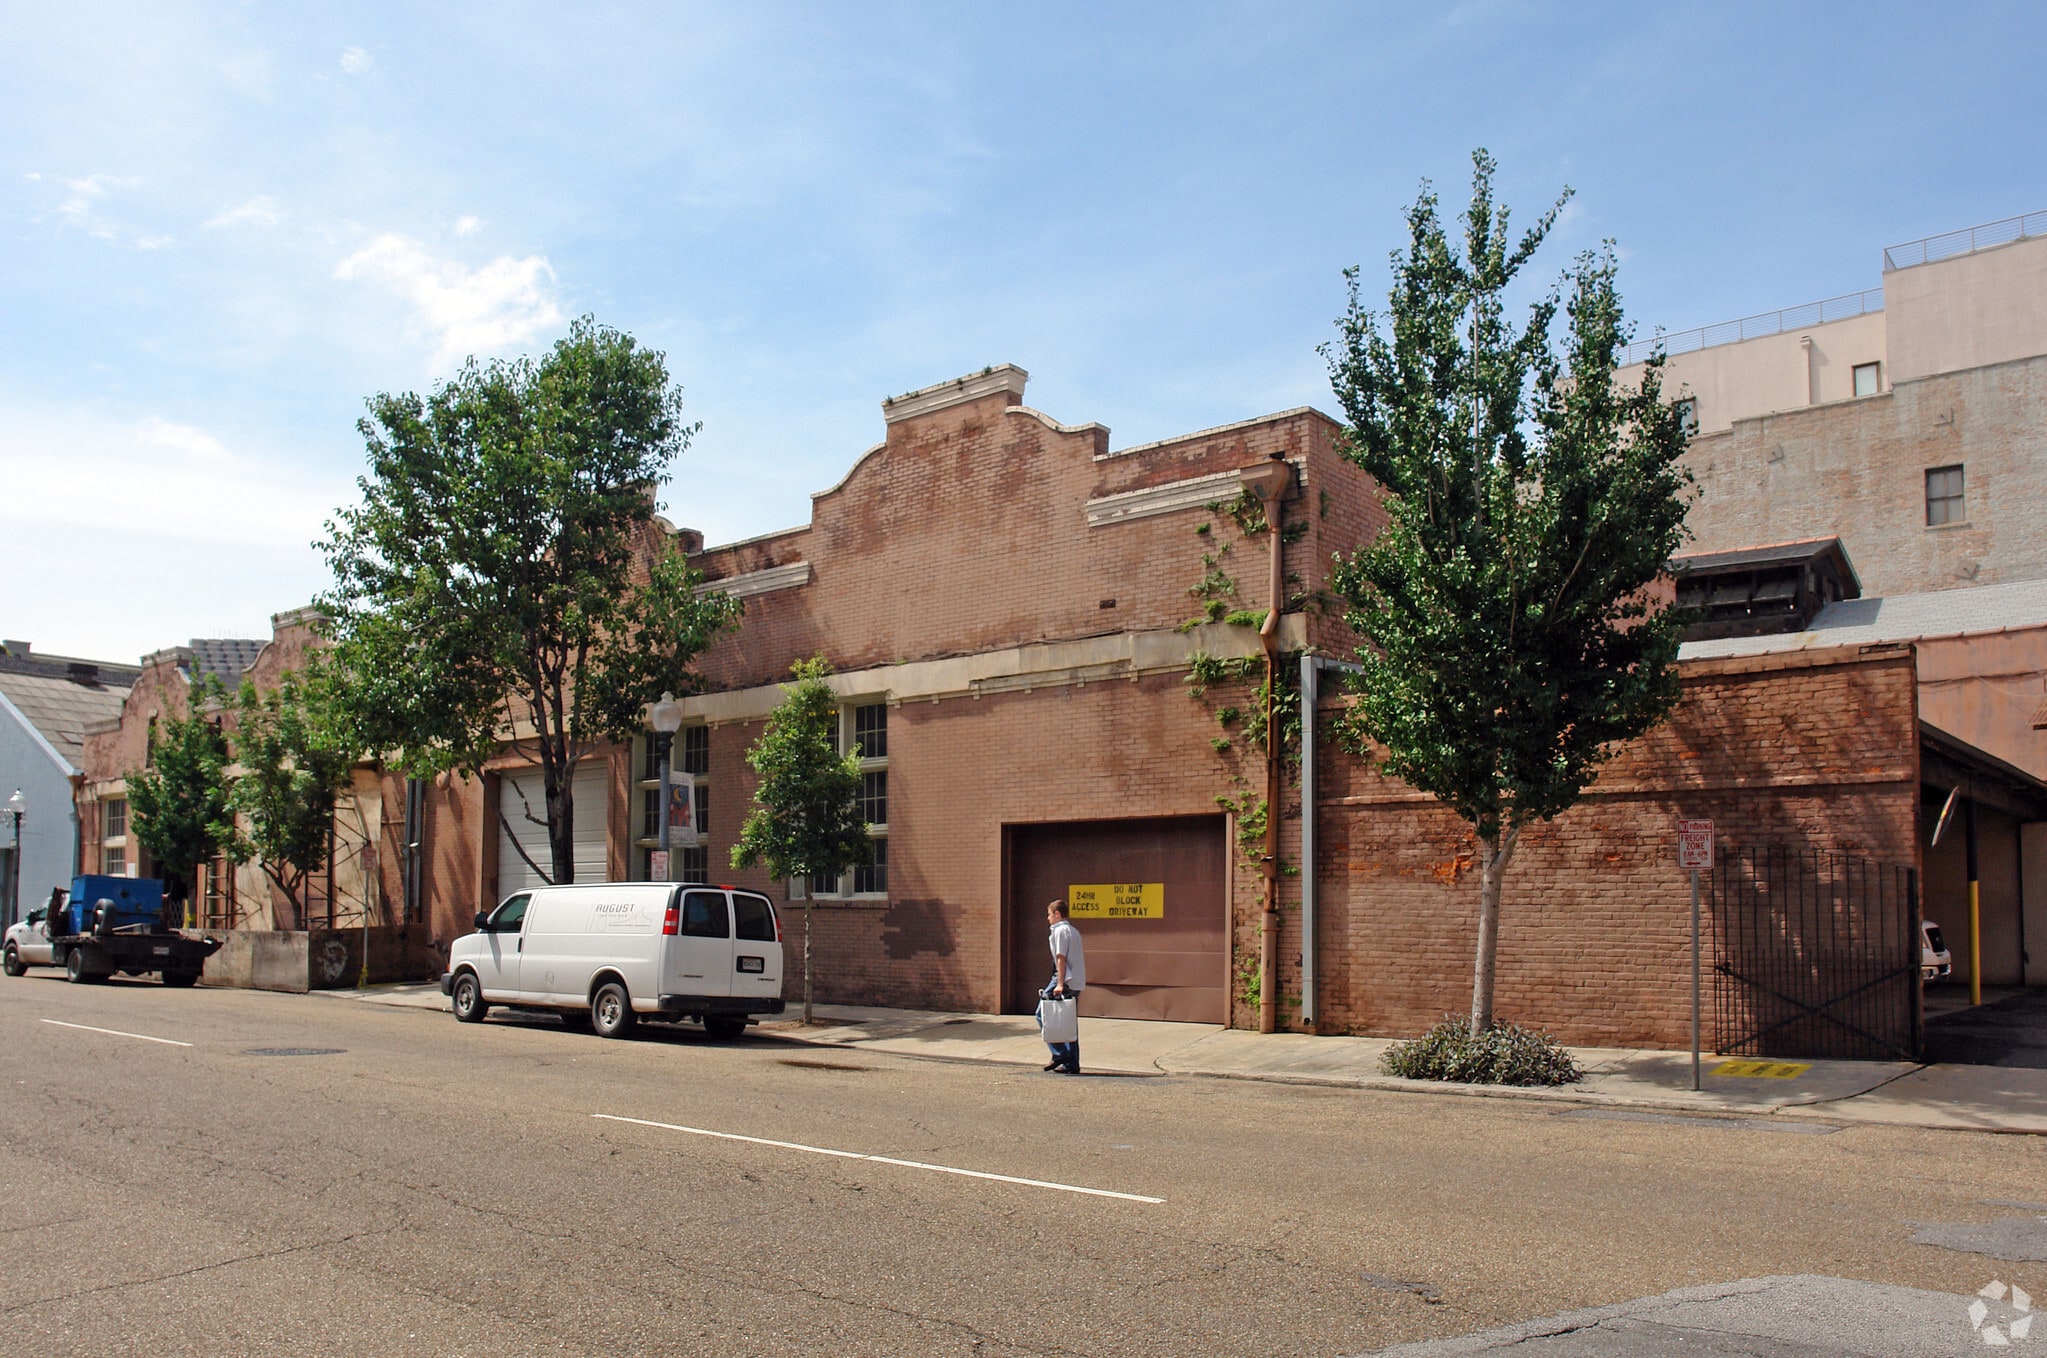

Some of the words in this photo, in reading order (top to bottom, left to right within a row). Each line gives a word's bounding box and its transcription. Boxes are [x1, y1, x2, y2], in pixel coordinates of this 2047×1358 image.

[1679, 822, 1688, 831] NO
[1686, 842, 1705, 850] ZONE
[1113, 885, 1124, 893] DO
[1128, 885, 1143, 893] NOT
[1115, 896, 1141, 905] BLOCK
[595, 903, 635, 913] AUGUST
[1071, 902, 1100, 911] ACCESS
[1108, 907, 1149, 916] DRIVEWAY
